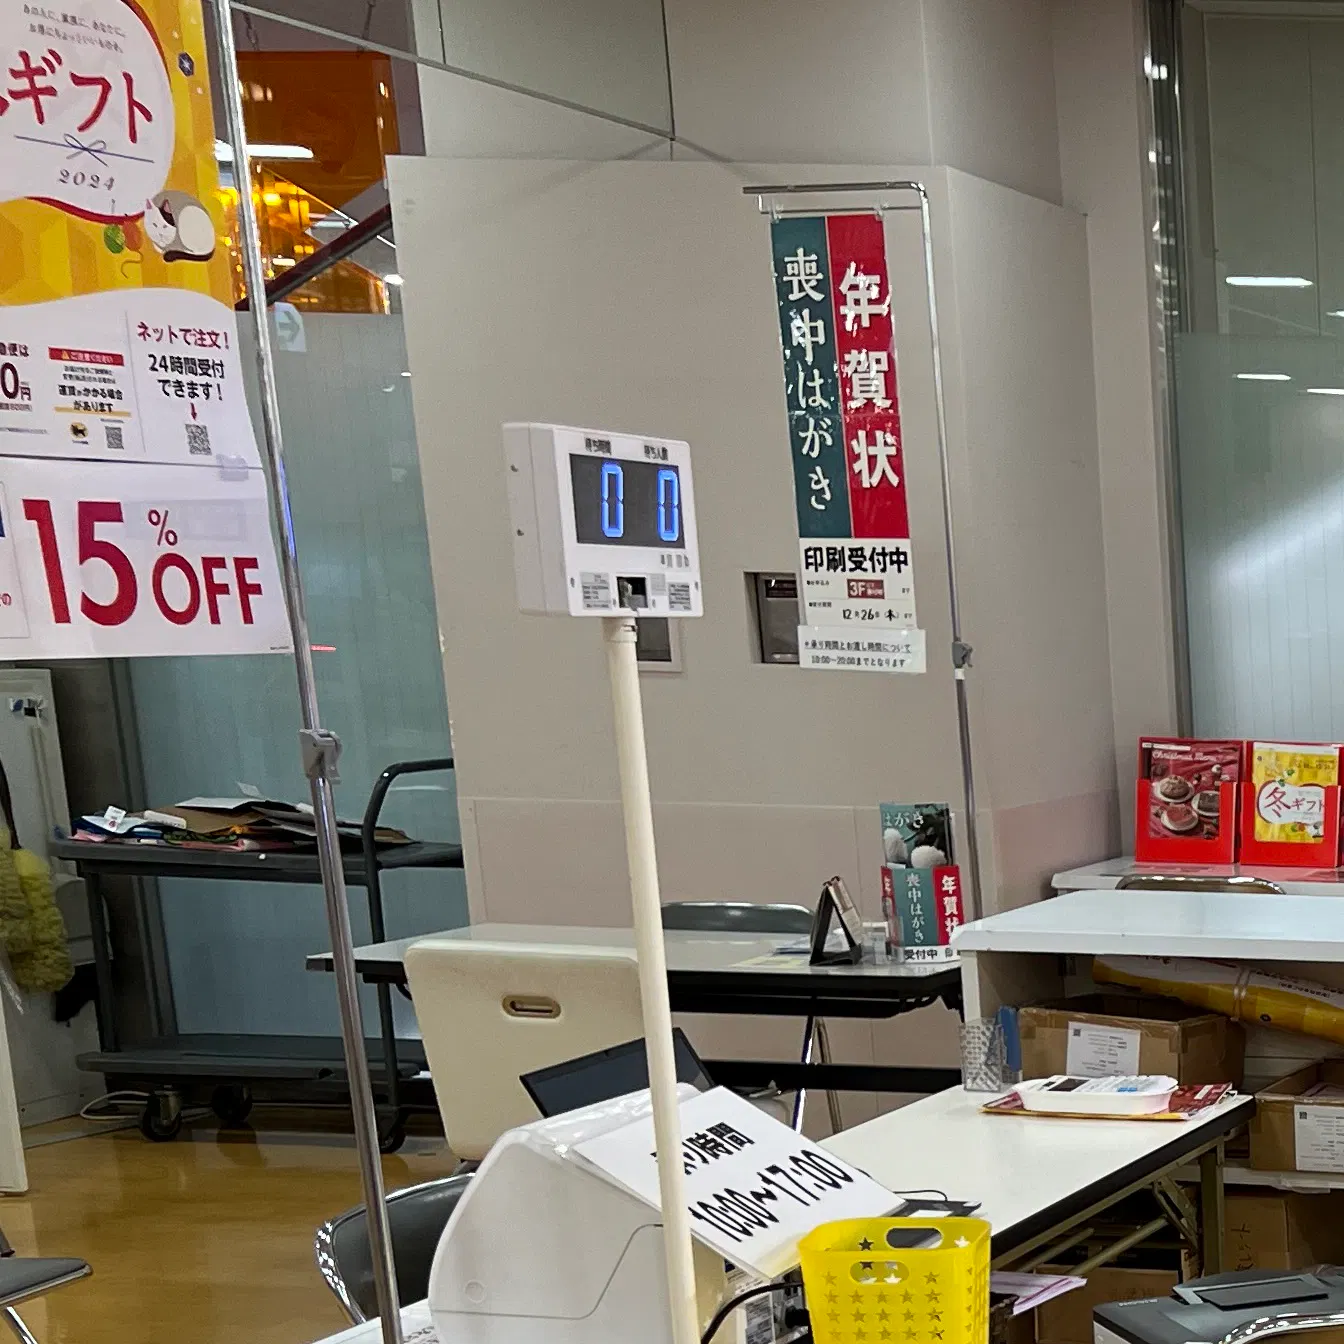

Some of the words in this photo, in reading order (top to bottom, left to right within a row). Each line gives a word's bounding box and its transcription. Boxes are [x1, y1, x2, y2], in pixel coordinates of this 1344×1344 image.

[58, 168, 115, 190] 2024
[148, 354, 225, 379] 24時間受付
[782, 247, 832, 510] 喪中はがき
[839, 261, 900, 488] 年賀状
[148, 509, 178, 546] %
[601, 461, 624, 537] 0
[657, 470, 679, 541] 0
[22, 499, 138, 625] 15
[804, 546, 909, 573] 印刷受付中
[152, 552, 263, 625] OFF
[849, 582, 866, 596] 3F
[1264, 787, 1324, 818] 冬ギフト
[906, 872, 925, 943] 喪中はがき
